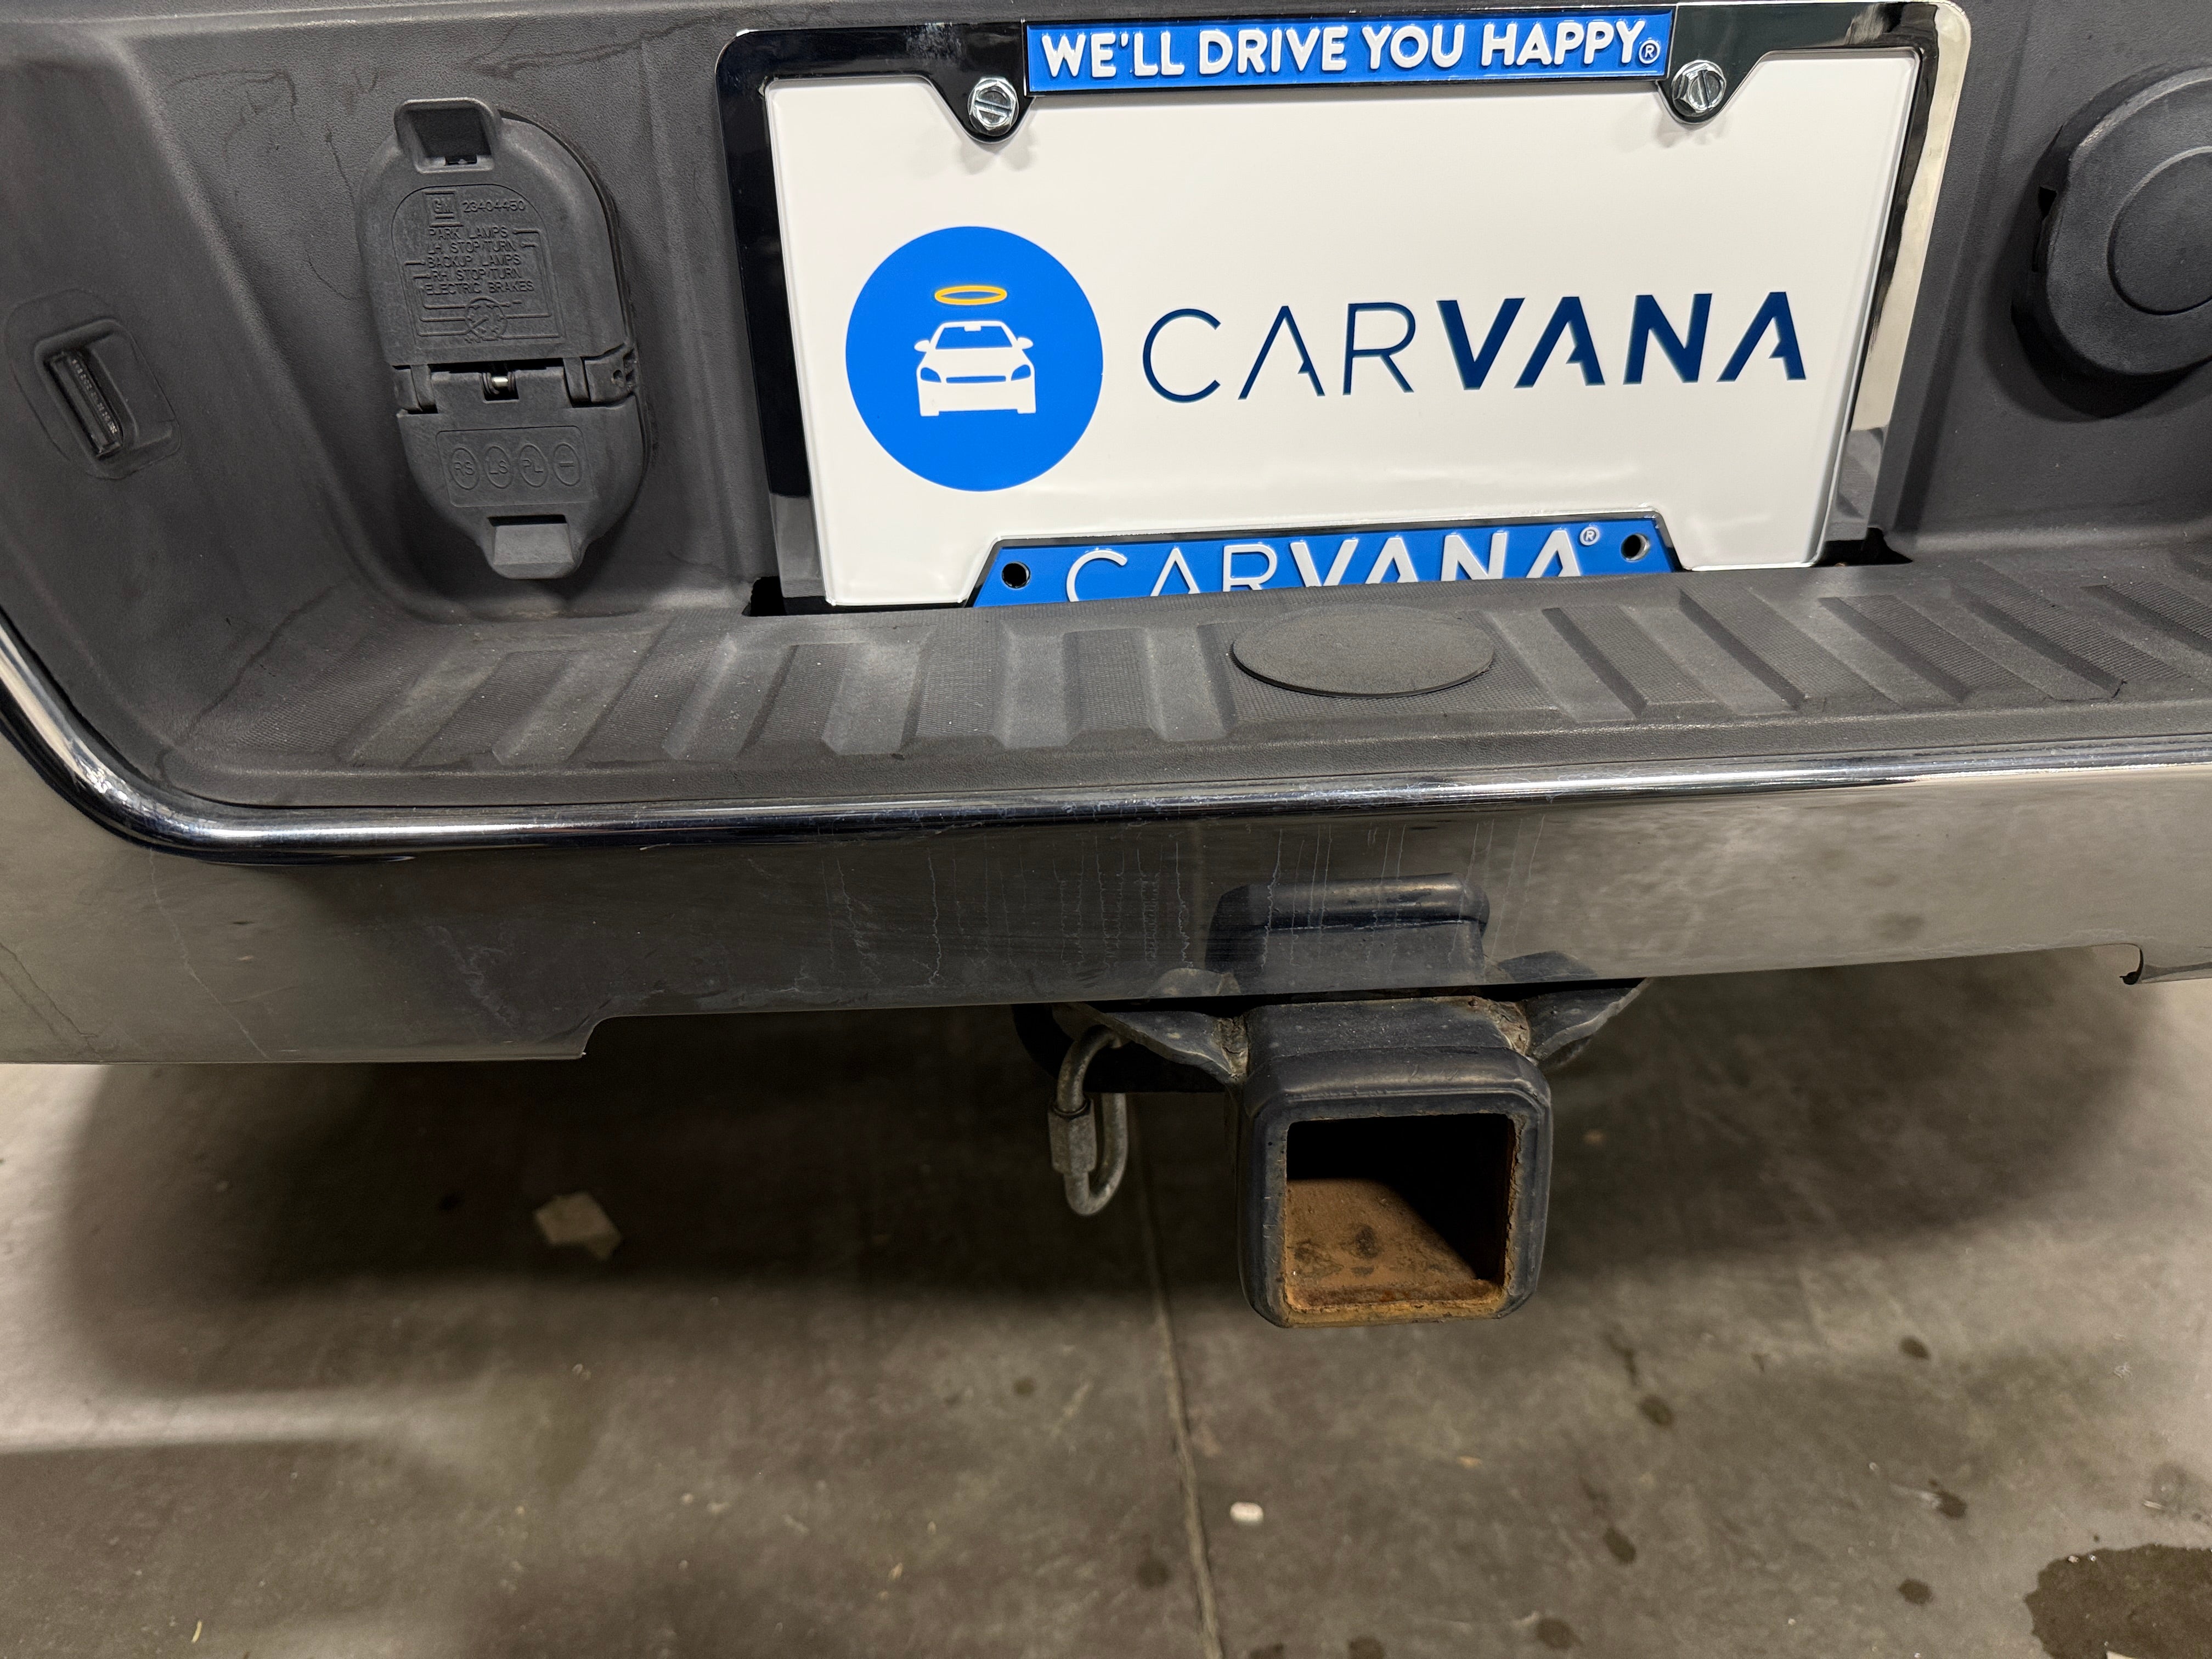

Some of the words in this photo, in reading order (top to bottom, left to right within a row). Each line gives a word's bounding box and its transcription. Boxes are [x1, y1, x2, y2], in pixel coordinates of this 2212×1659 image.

[1042, 31, 1185, 77] WE'LL
[1199, 26, 1348, 75] DRIVE
[1362, 24, 1465, 70] YOU
[462, 198, 527, 213] 23404450
[429, 227, 461, 240] PARK
[469, 224, 509, 239] LAMPS
[428, 241, 444, 254] LH
[427, 254, 472, 268] BACKUP
[481, 252, 521, 267] LAMPS
[431, 268, 448, 281] RH
[425, 281, 482, 295] ELECTRIC
[487, 280, 535, 294] BRAKES
[1142, 291, 1807, 404] CARVANA
[454, 460, 475, 476] RS
[488, 459, 509, 475] LS
[522, 459, 544, 473] PL
